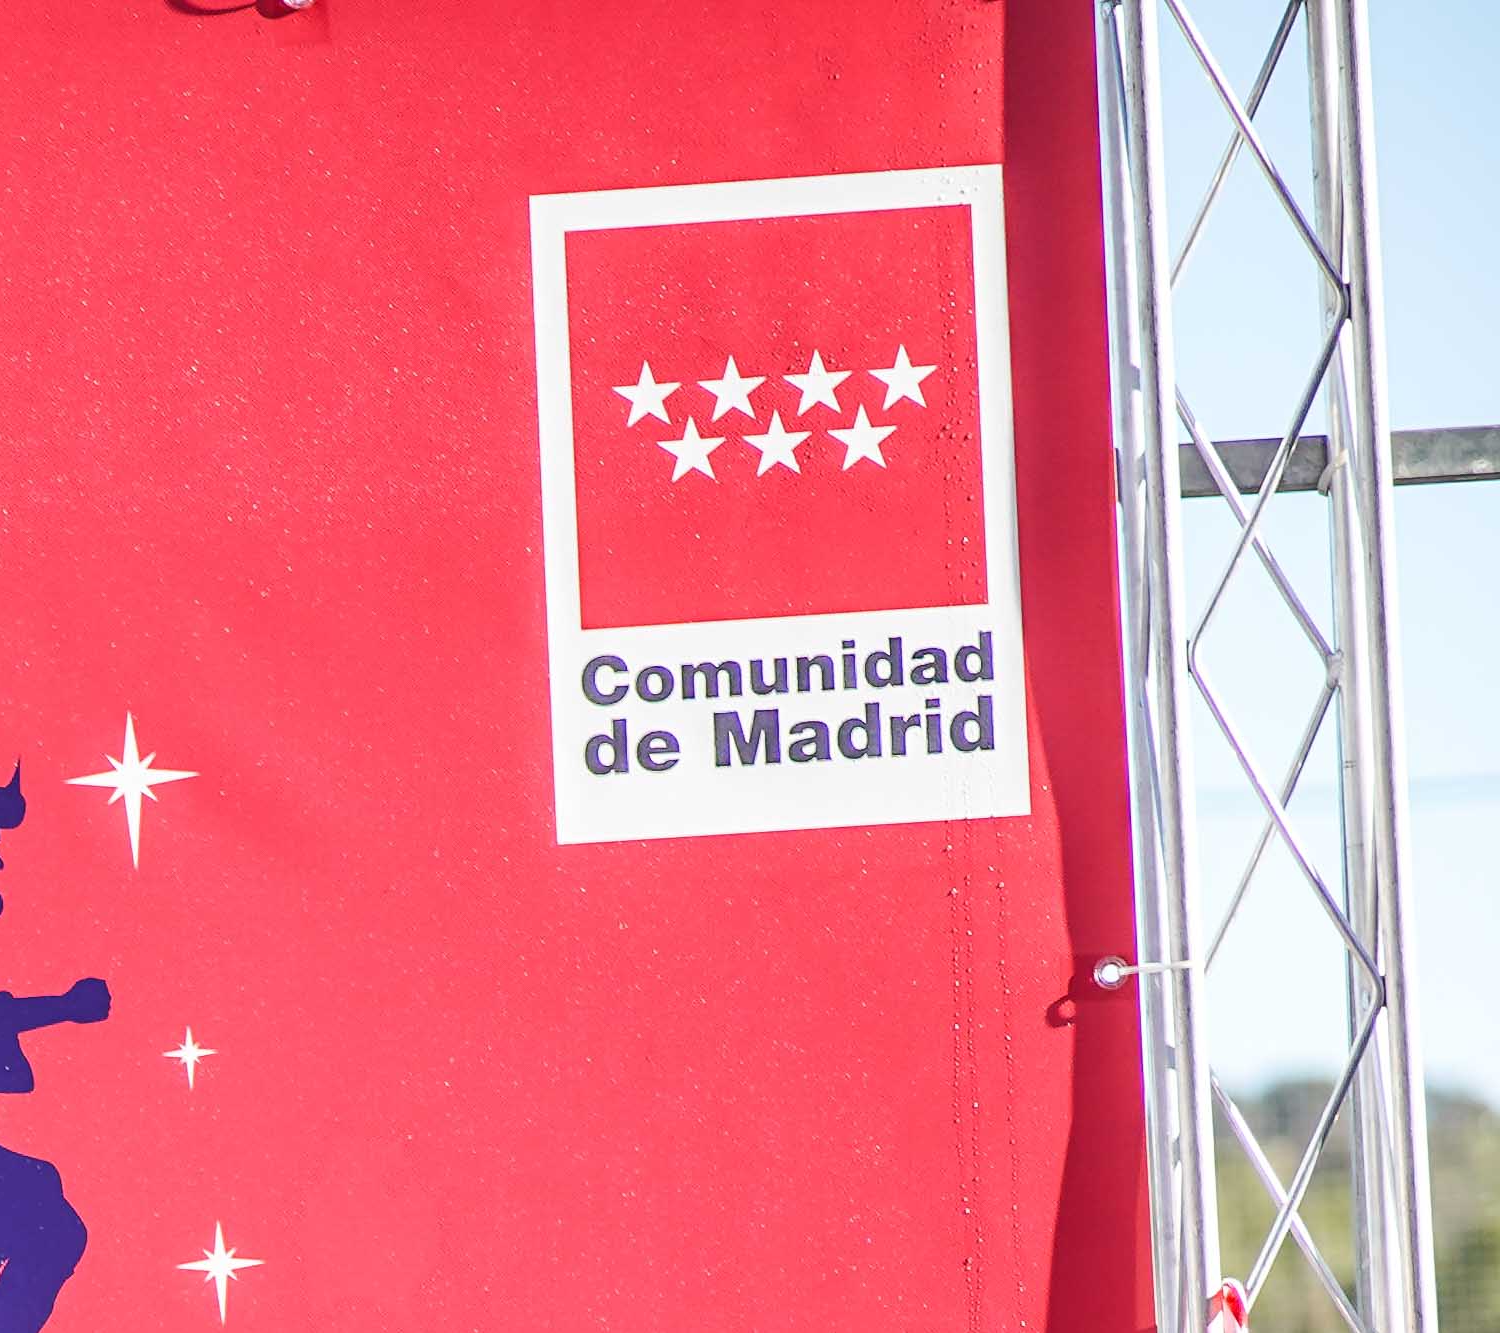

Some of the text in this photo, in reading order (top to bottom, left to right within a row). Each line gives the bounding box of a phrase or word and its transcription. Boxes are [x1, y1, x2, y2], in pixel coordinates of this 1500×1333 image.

[581, 631, 994, 706] Comunidad
[584, 695, 995, 775] de Madrid
